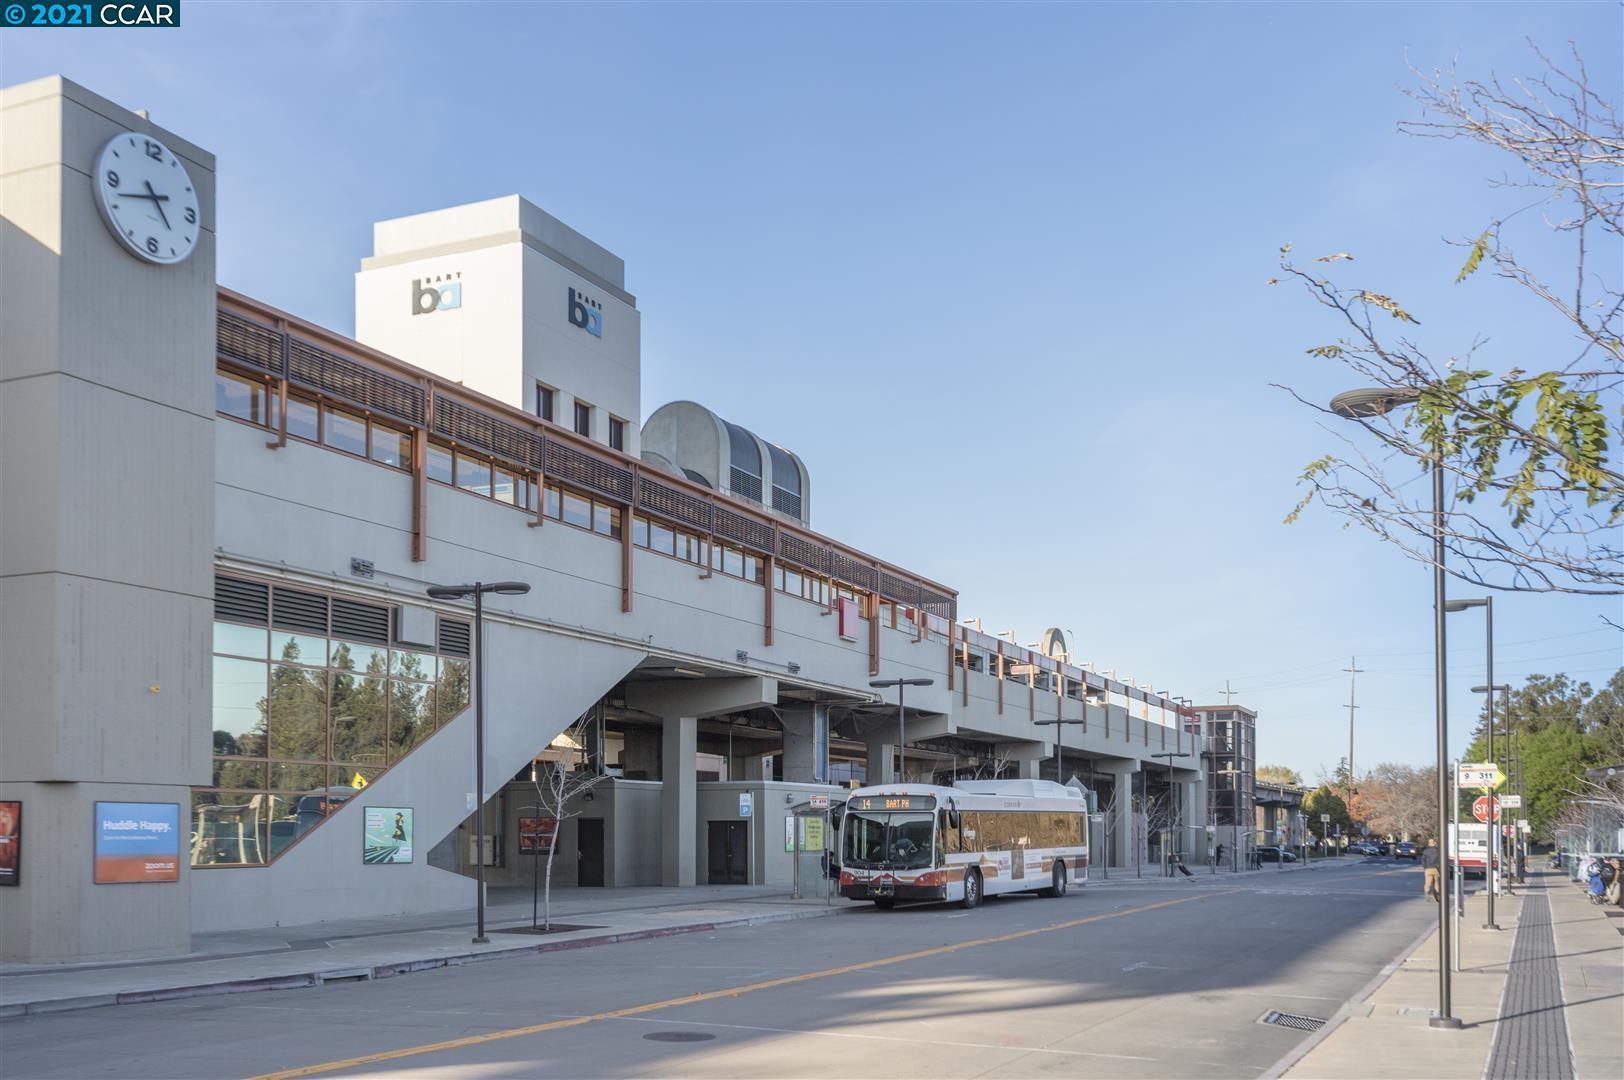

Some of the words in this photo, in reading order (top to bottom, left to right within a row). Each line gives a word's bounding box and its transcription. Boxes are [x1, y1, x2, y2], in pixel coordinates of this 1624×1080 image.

[144, 140, 163, 163] 12
[106, 170, 120, 188] 9
[184, 206, 196, 225] 3
[146, 236, 158, 254] 6
[425, 271, 462, 284] BART
[577, 292, 602, 312] BART
[1479, 772, 1493, 780] 311
[862, 799, 871, 809] 14
[885, 799, 900, 809] BART
[1475, 804, 1500, 815] STP
[103, 820, 138, 831] Huddle
[139, 820, 172, 833] Happy.
